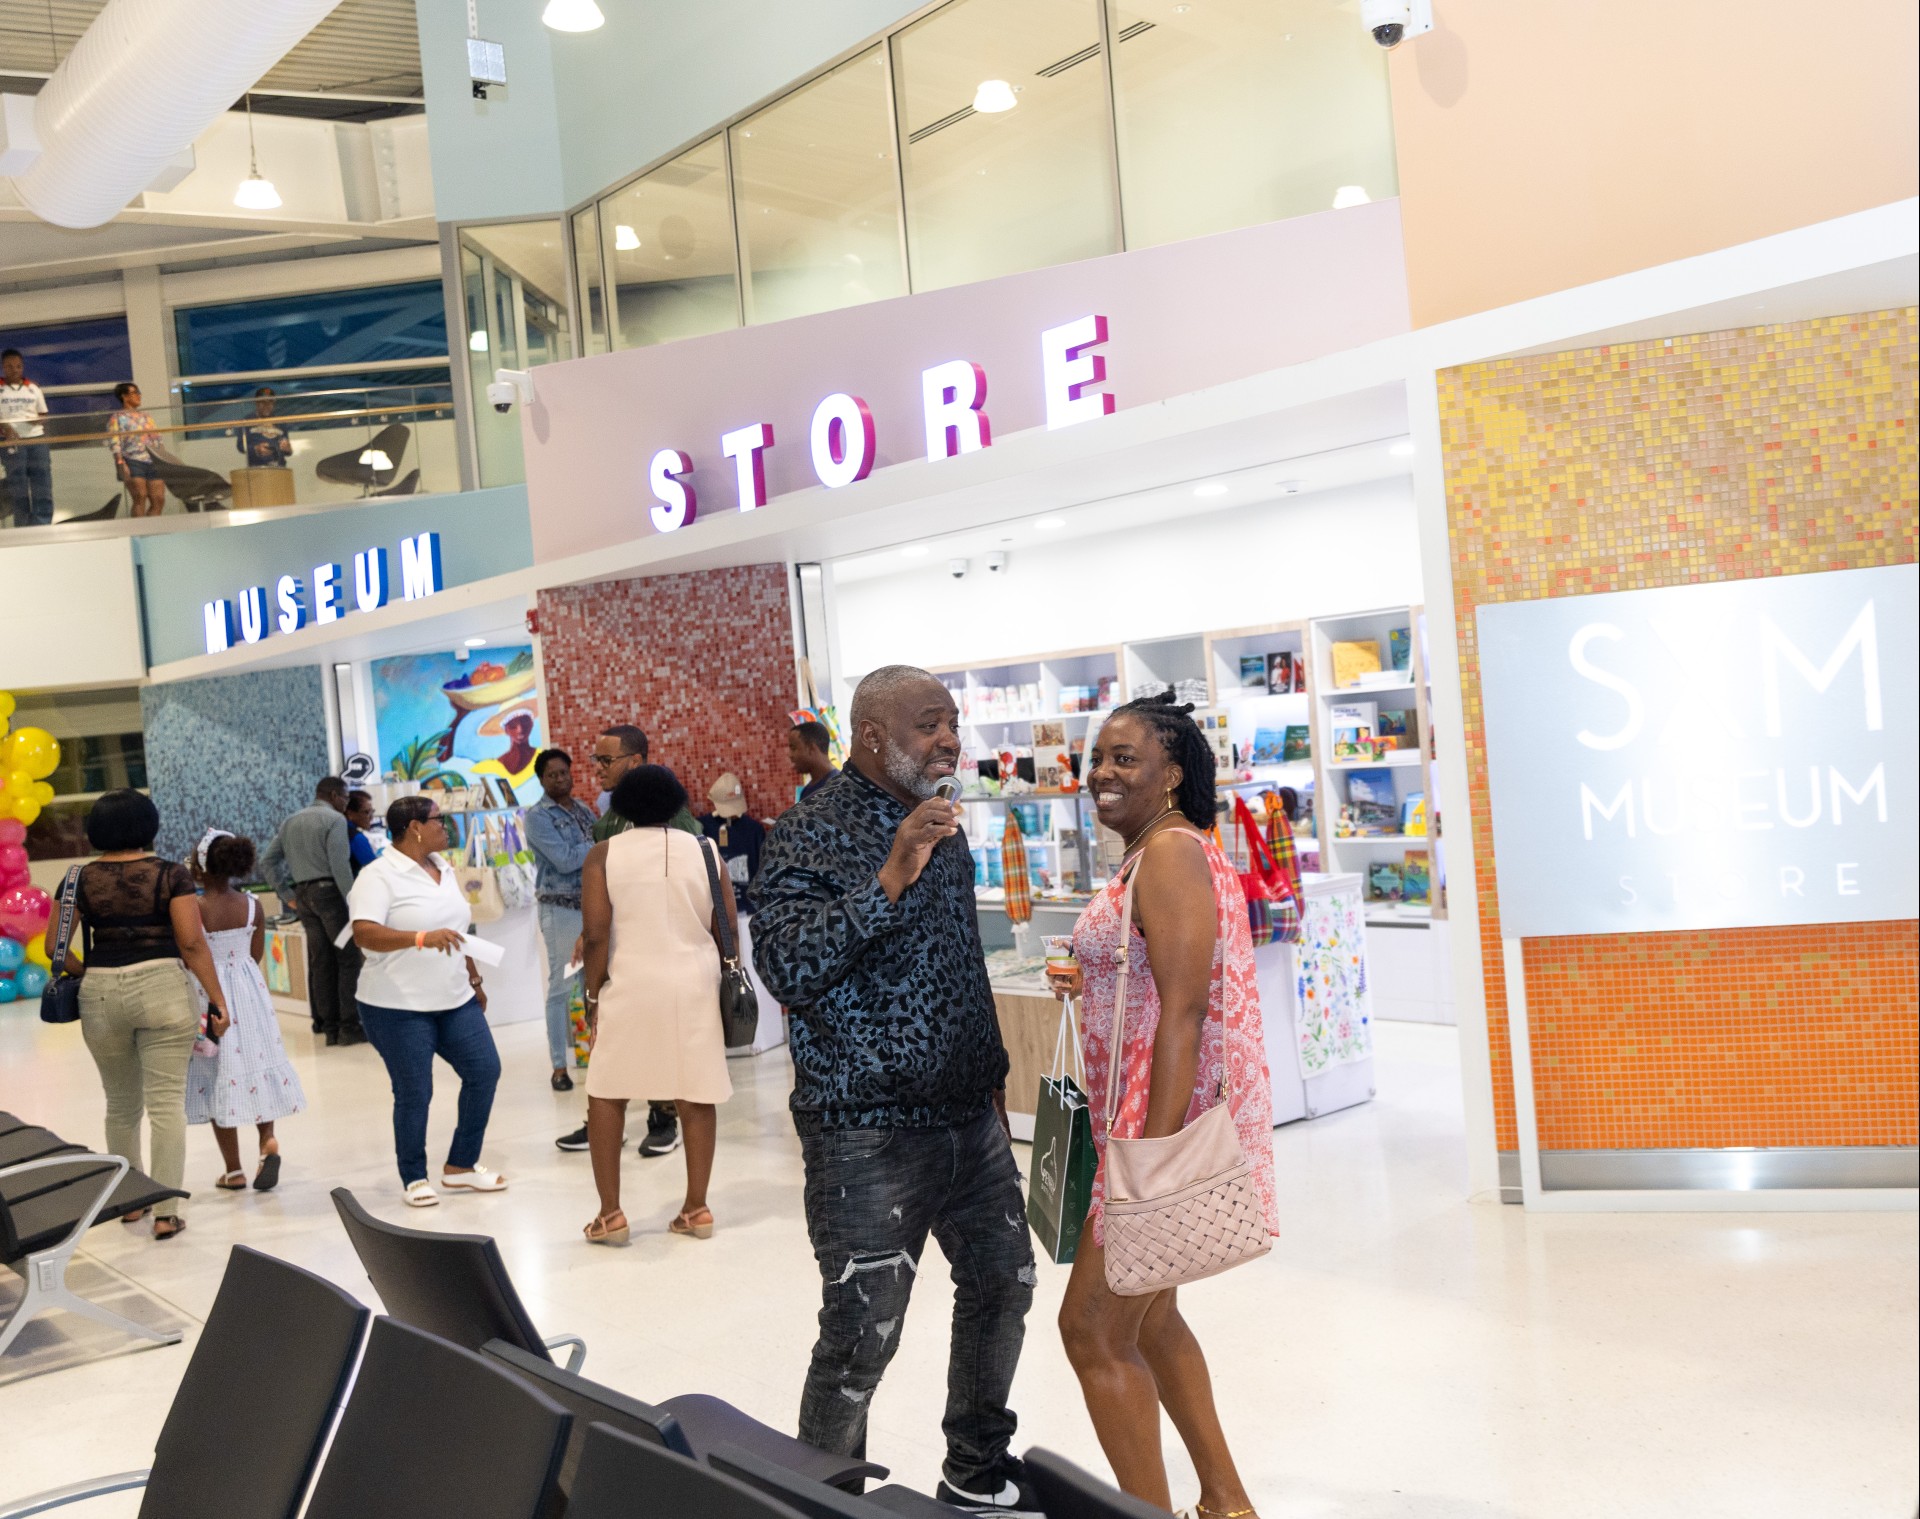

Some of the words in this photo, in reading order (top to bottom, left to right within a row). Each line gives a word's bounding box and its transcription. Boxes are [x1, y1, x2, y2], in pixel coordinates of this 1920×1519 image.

[650, 314, 1115, 532] STORE
[204, 532, 442, 655] MUSEUM
[1568, 597, 1883, 752] SXM
[1580, 761, 1888, 841] MUSEUM
[1618, 862, 1861, 905] STORE
